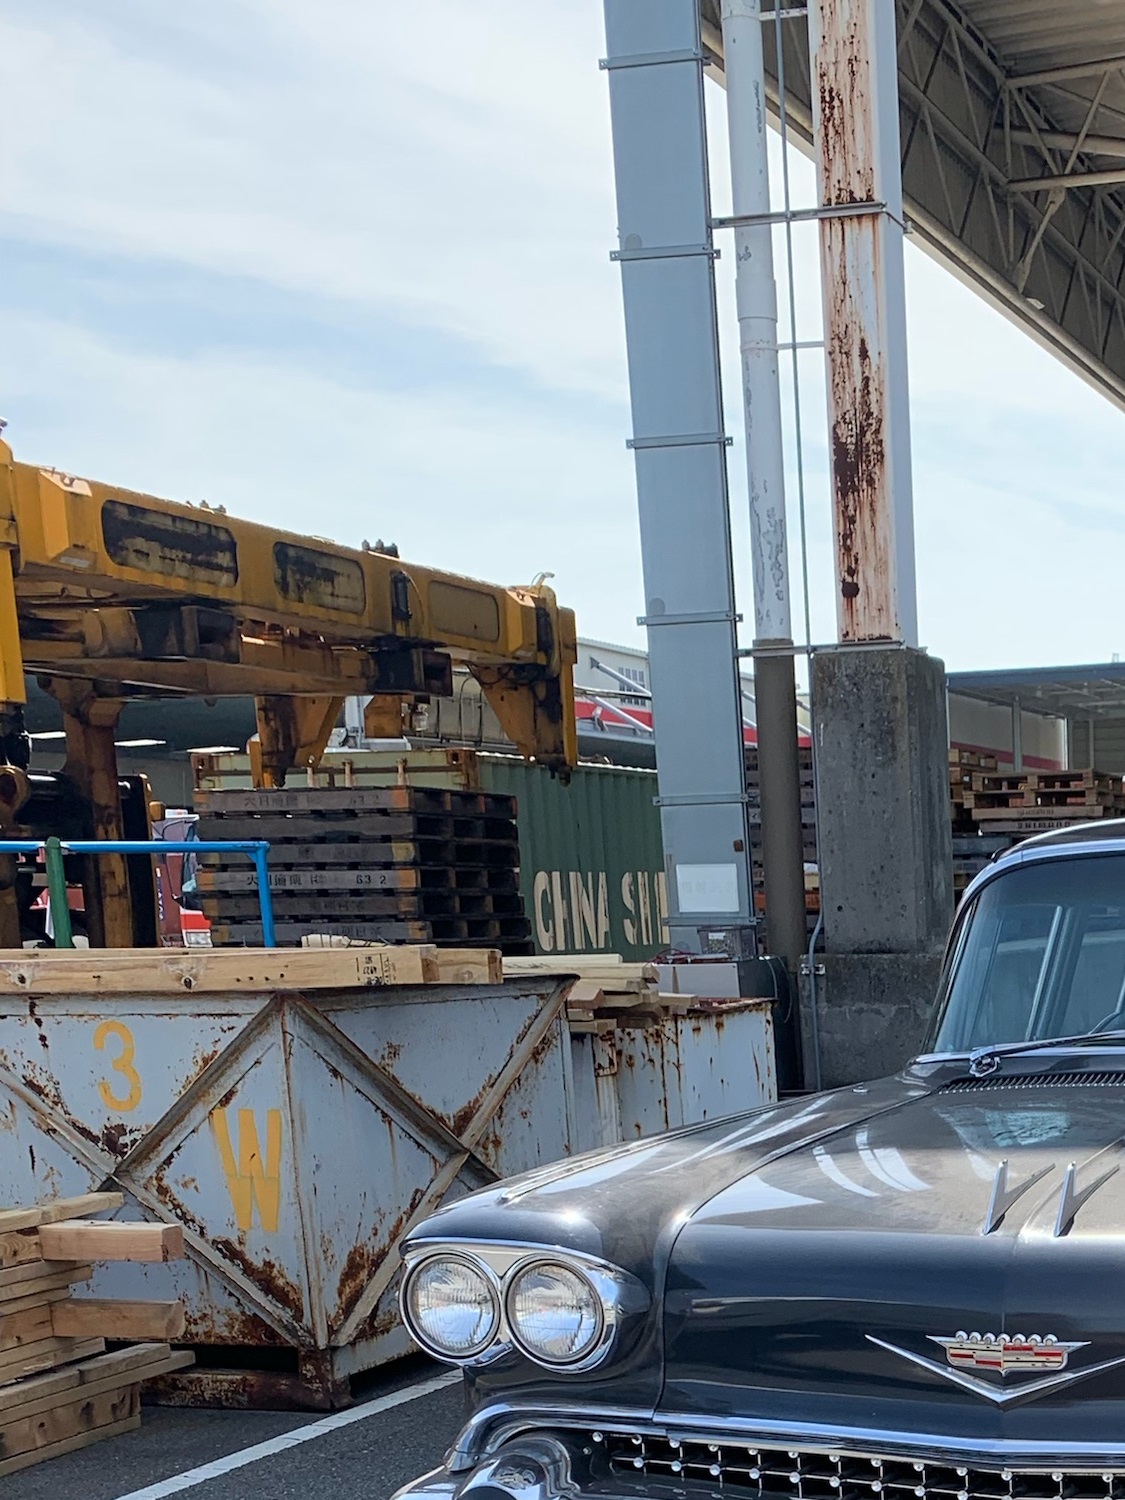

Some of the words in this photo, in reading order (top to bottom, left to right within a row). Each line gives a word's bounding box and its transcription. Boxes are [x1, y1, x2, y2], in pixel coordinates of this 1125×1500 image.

[380, 875, 387, 885] 2
[534, 871, 612, 952] CHINA
[93, 1020, 142, 1113] 3
[210, 1108, 282, 1233] W
